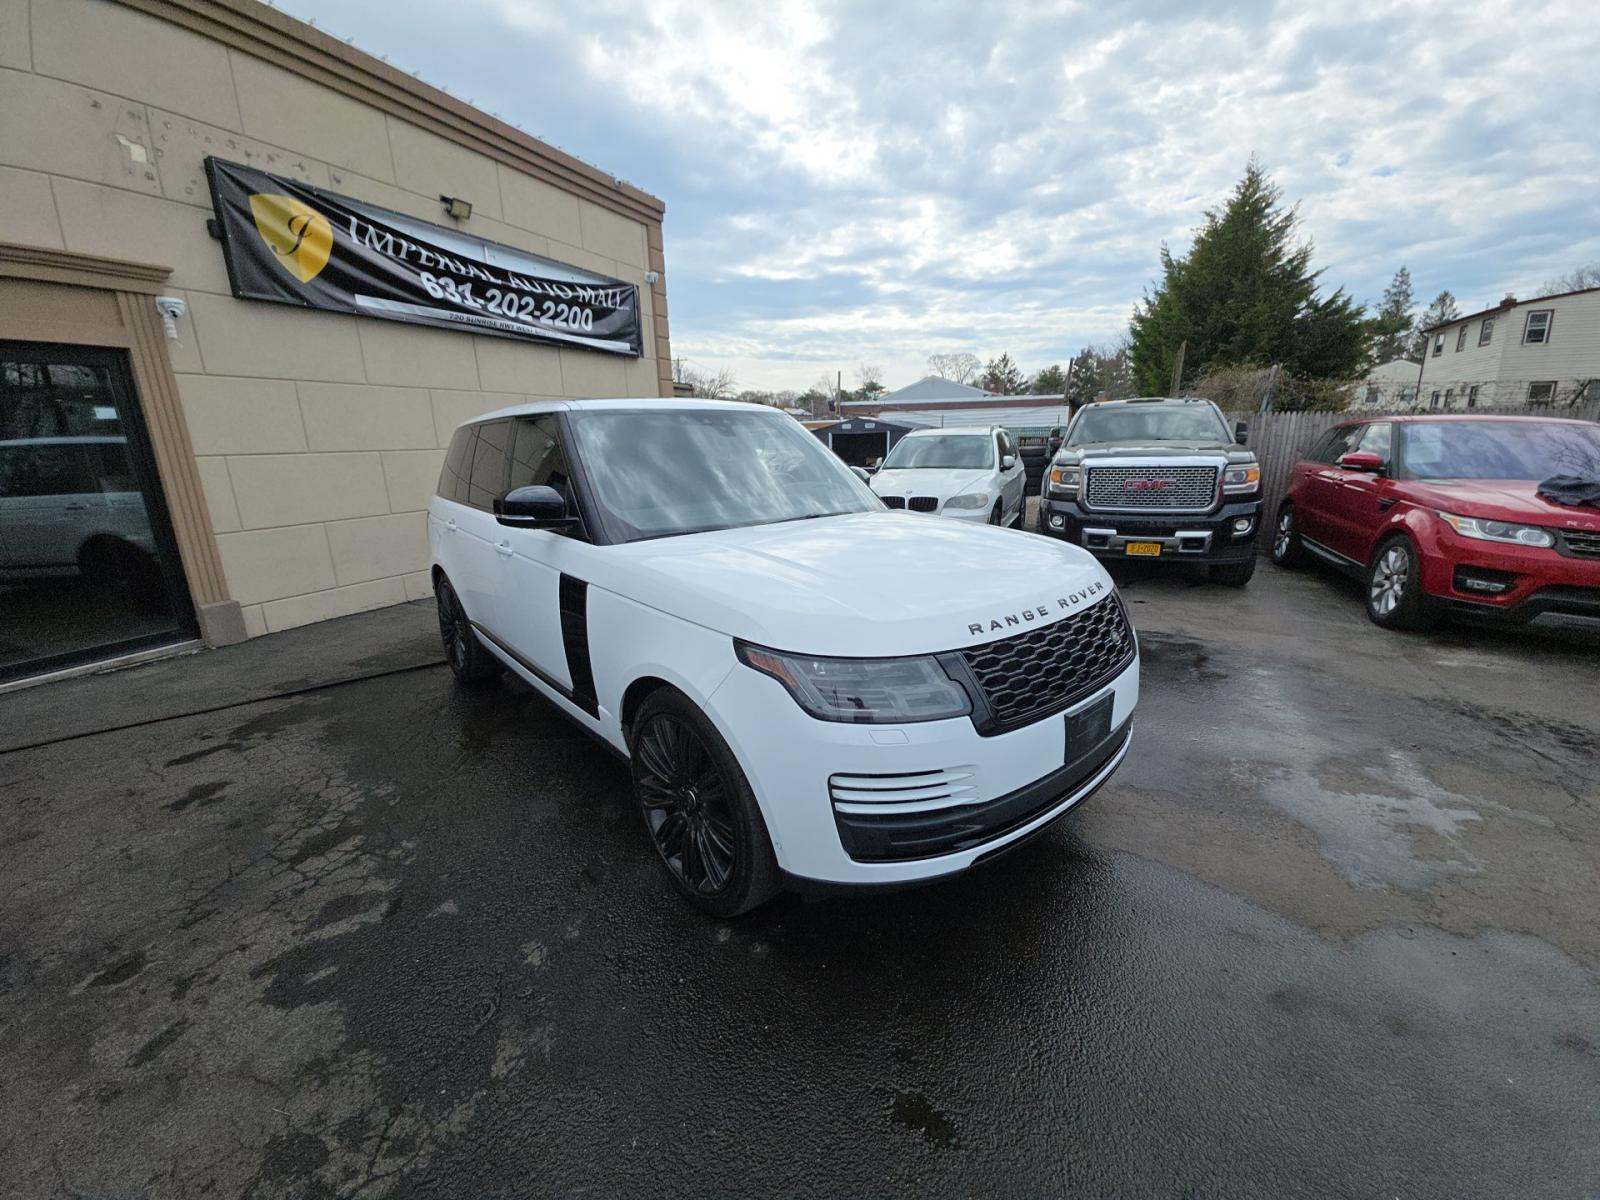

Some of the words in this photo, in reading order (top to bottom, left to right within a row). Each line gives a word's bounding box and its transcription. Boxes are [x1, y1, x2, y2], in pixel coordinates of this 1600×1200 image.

[420, 271, 593, 331] 631-202-2200
[1123, 479, 1177, 490] GMC
[968, 605, 1049, 635] RANGE
[1057, 581, 1104, 609] ROVER
